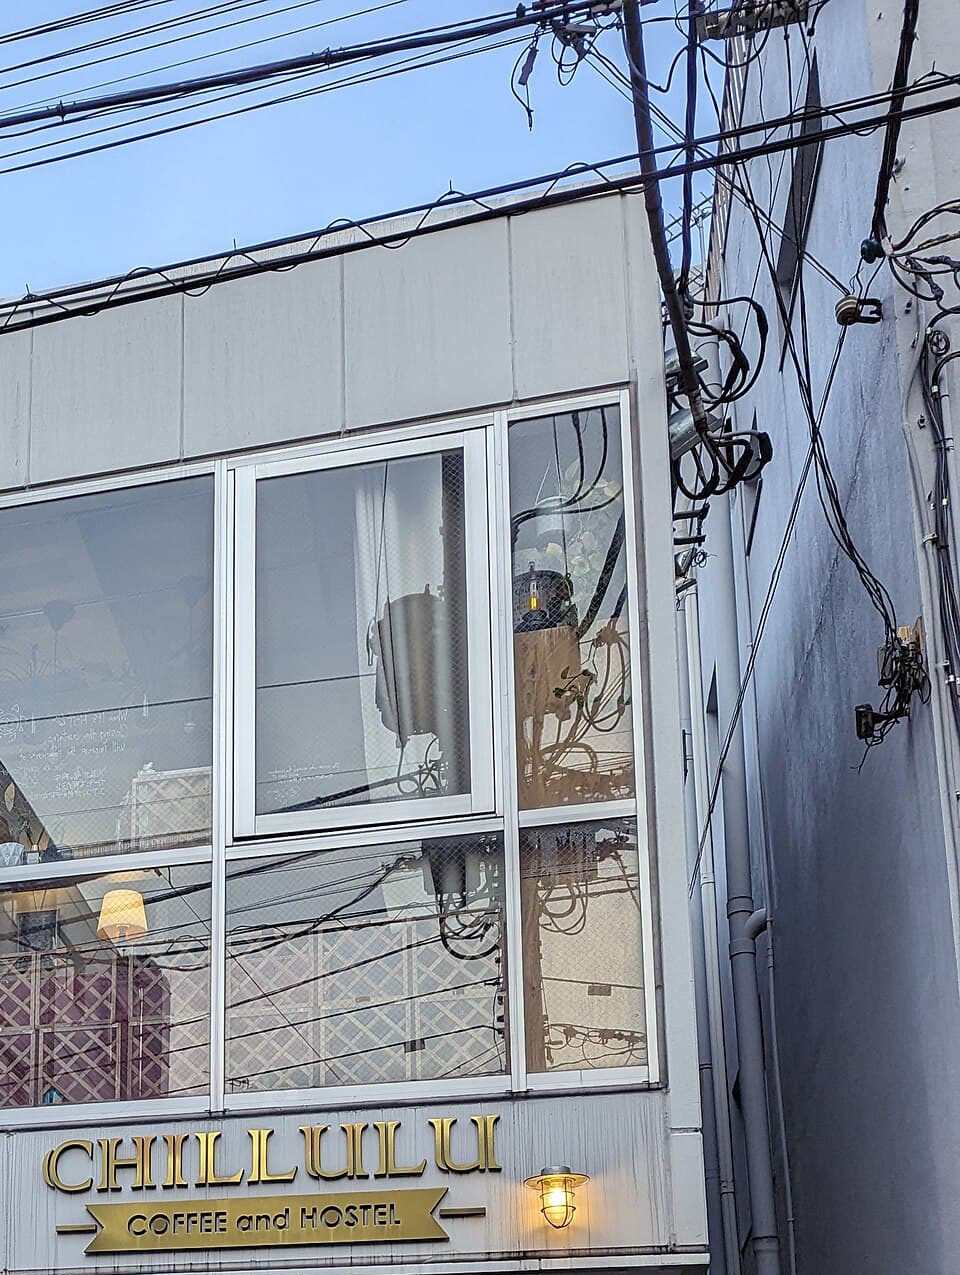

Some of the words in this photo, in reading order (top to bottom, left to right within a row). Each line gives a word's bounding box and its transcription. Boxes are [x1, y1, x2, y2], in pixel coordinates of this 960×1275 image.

[42, 1114, 502, 1192] CHILLULU
[127, 1211, 227, 1237] COFFEE
[236, 1207, 290, 1232] and
[299, 1203, 401, 1229] HOSTEL
